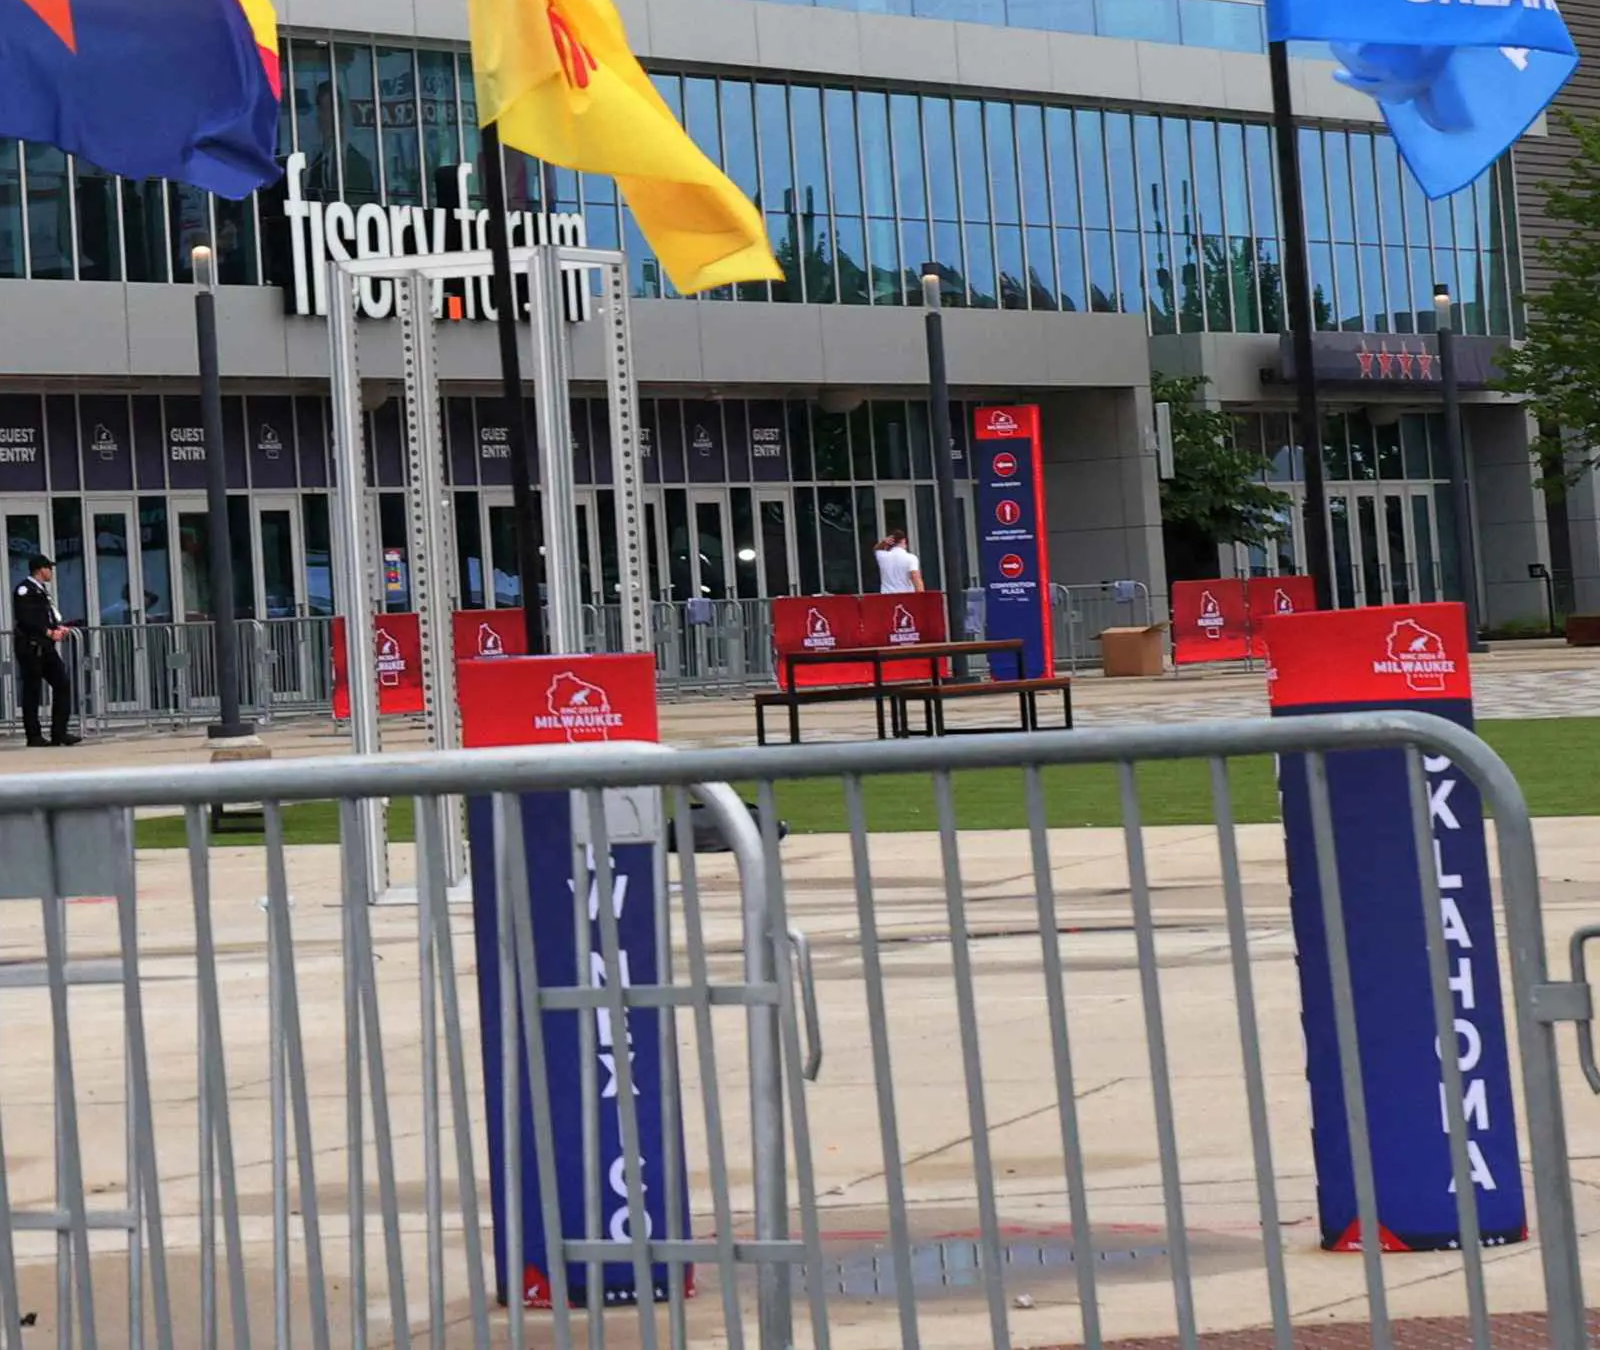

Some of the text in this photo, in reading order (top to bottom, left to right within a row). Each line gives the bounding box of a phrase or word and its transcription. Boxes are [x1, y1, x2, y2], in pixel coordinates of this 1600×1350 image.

[481, 428, 508, 441] GUES
[0, 447, 36, 462] ENTRY
[1373, 660, 1456, 673] MILWAUKEE
[535, 713, 623, 729] MILWAUKEE
[1423, 752, 1497, 1193] KLAHOMA
